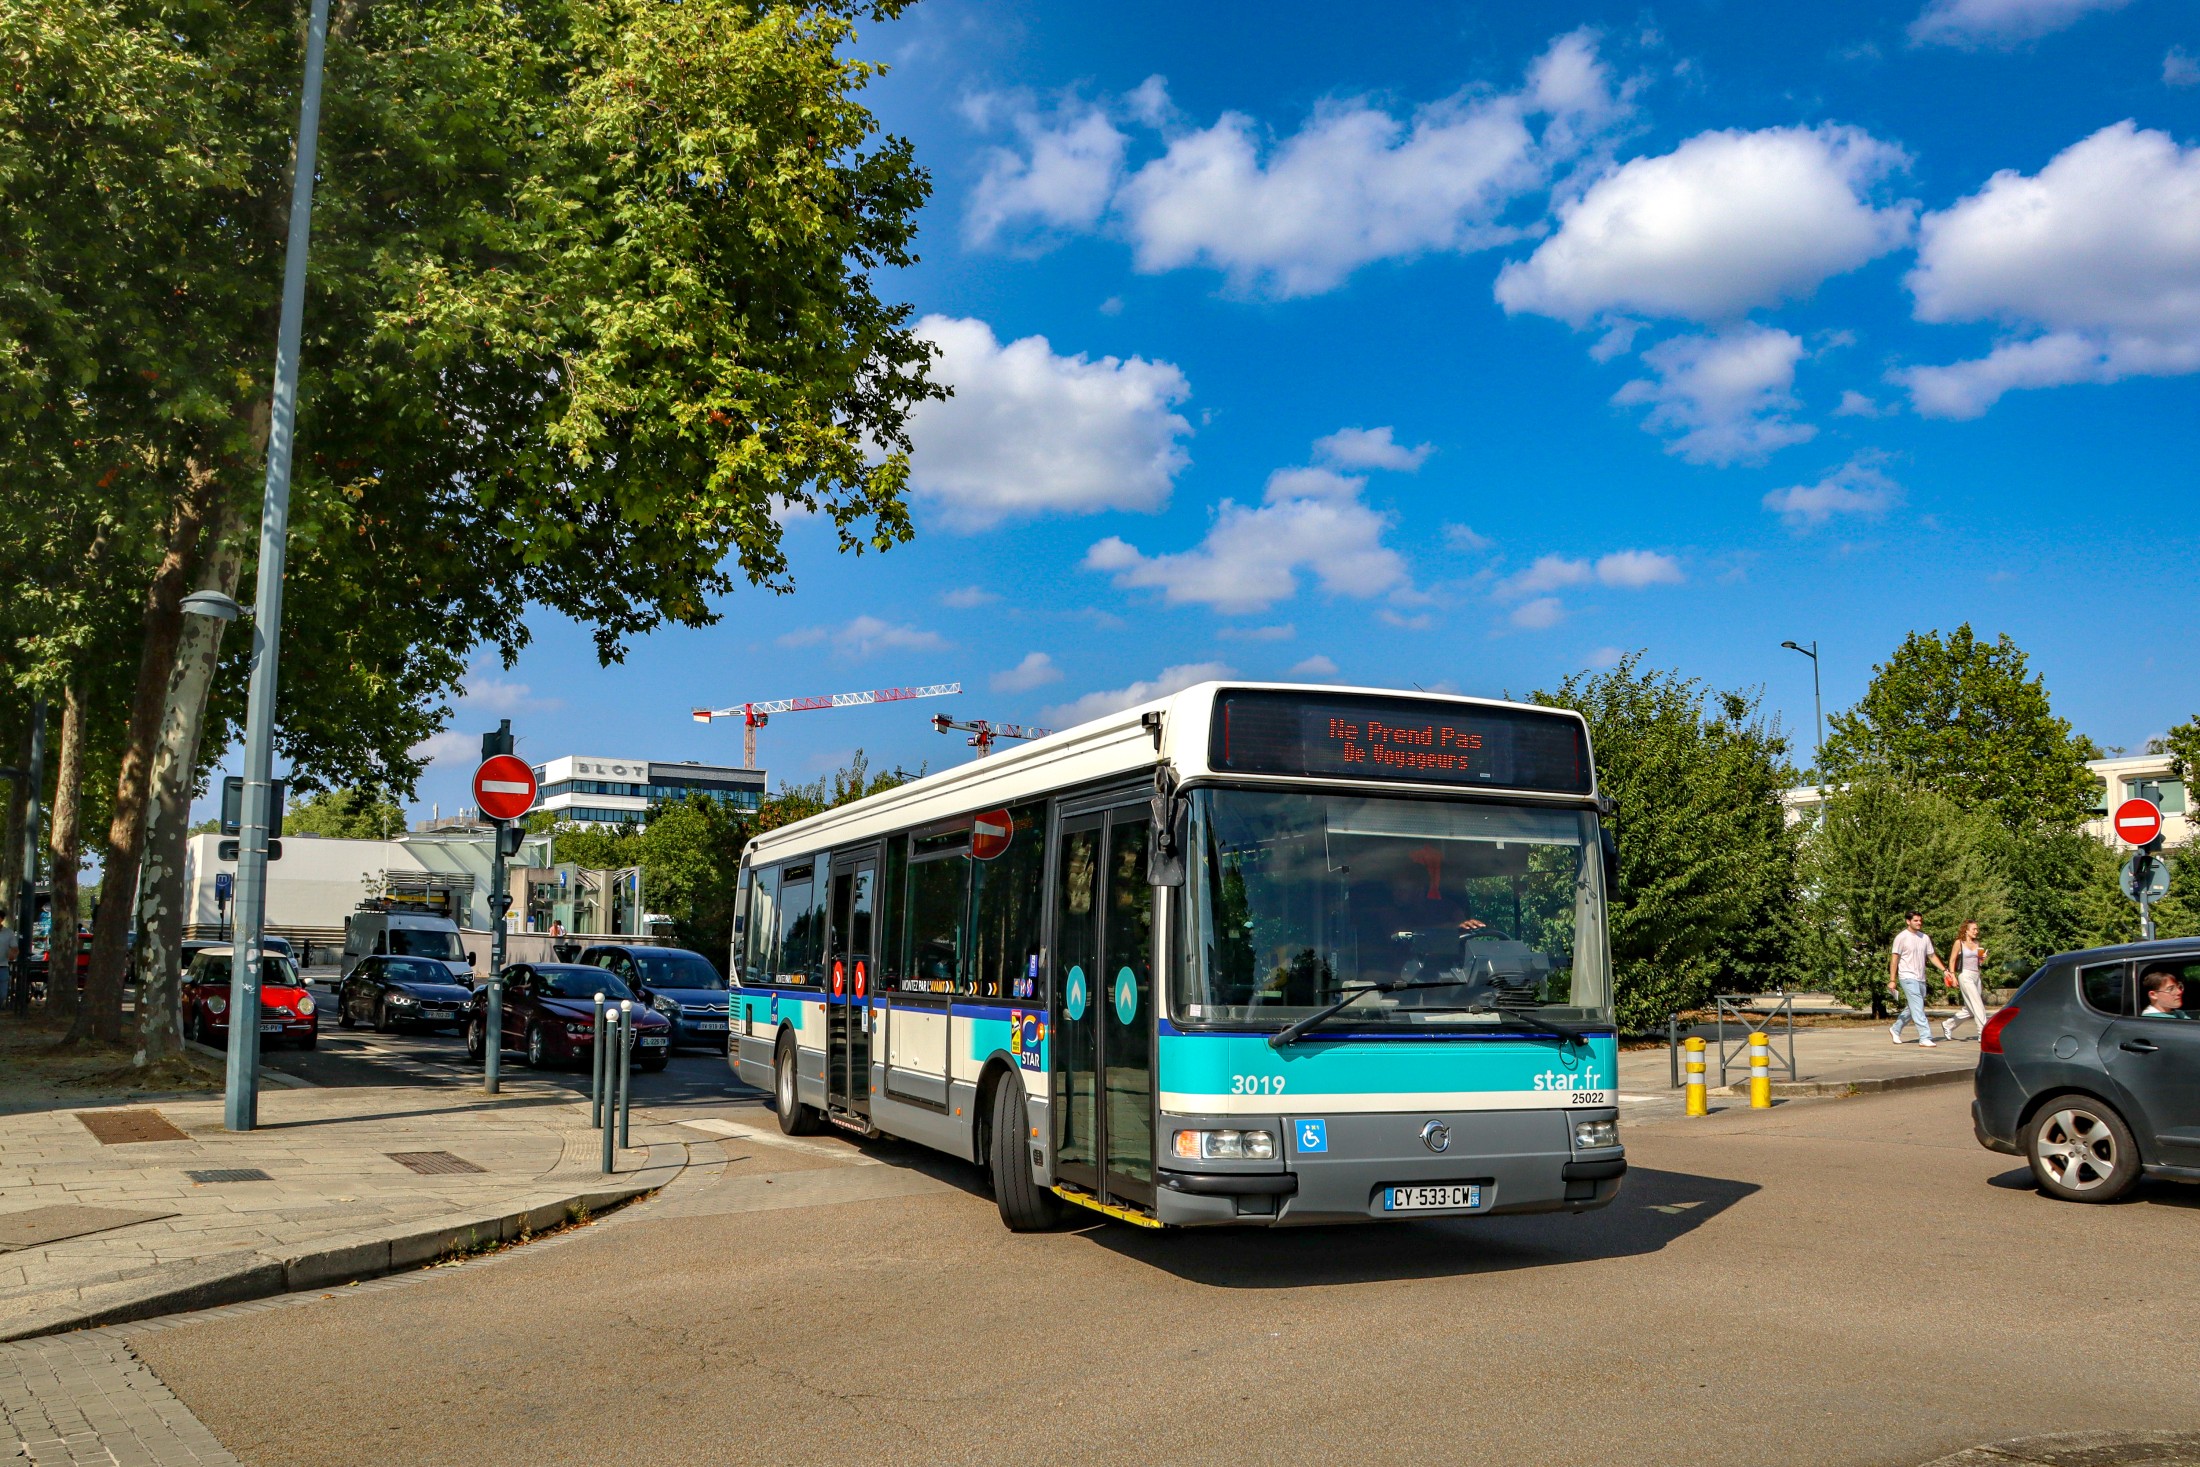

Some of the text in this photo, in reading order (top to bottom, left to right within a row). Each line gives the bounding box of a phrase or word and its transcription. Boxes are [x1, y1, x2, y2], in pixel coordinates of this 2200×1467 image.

[1329, 718, 1482, 749] Ne Prend Pas
[1344, 742, 1468, 770] De Voyageurs
[579, 763, 644, 777] BLOT
[1021, 1051, 1040, 1067] STAR
[1231, 1075, 1286, 1095] 3019
[1533, 1066, 1601, 1090] star.fr
[1572, 1092, 1604, 1104] 25022
